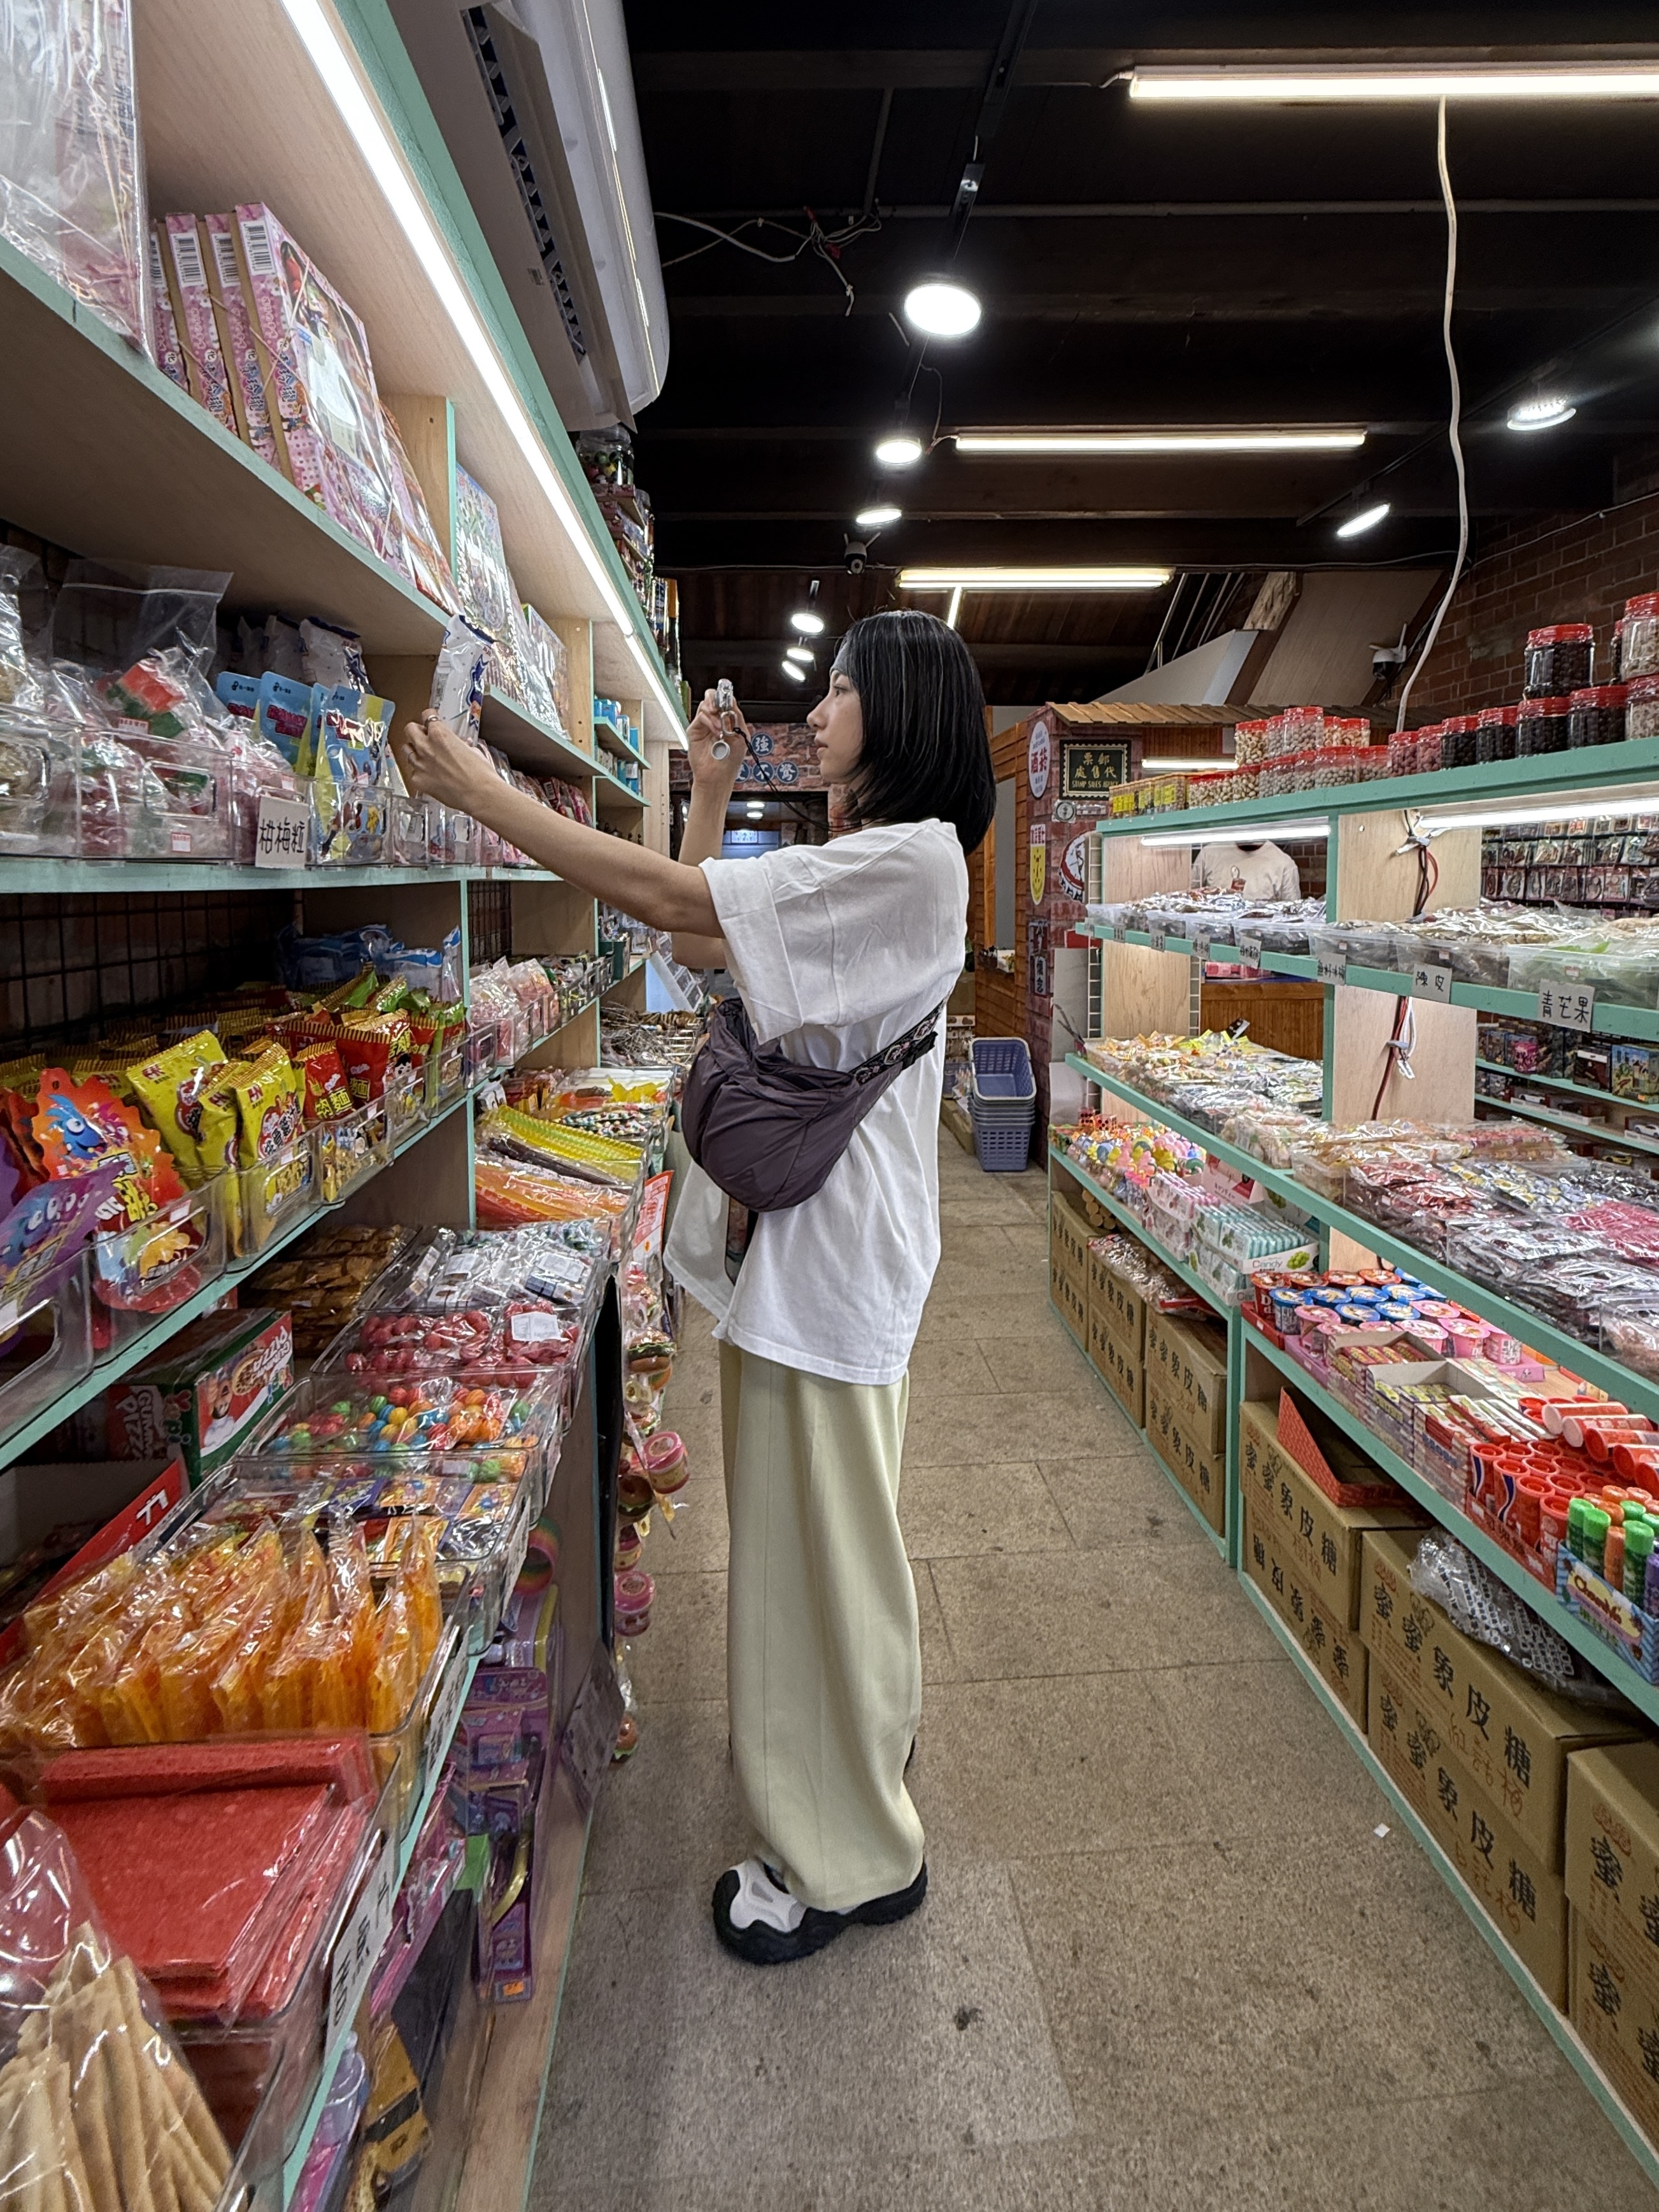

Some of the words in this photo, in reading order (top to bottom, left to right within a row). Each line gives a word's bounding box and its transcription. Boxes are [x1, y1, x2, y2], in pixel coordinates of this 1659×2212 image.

[755, 736, 770, 753] 強
[1072, 780, 1086, 788] STAMP
[1088, 780, 1102, 788] SALES
[1415, 971, 1444, 992] 陳皮
[1542, 990, 1590, 1023] 青芒果
[1253, 1260, 1283, 1269] Candy
[253, 1325, 288, 1373] PIZZA
[1246, 1441, 1336, 1576] 蜜蜜象皮糖
[1374, 1582, 1531, 1788] 蜜蜜象皮糖
[1380, 1694, 1536, 1924] 蜜蜜象皮糖
